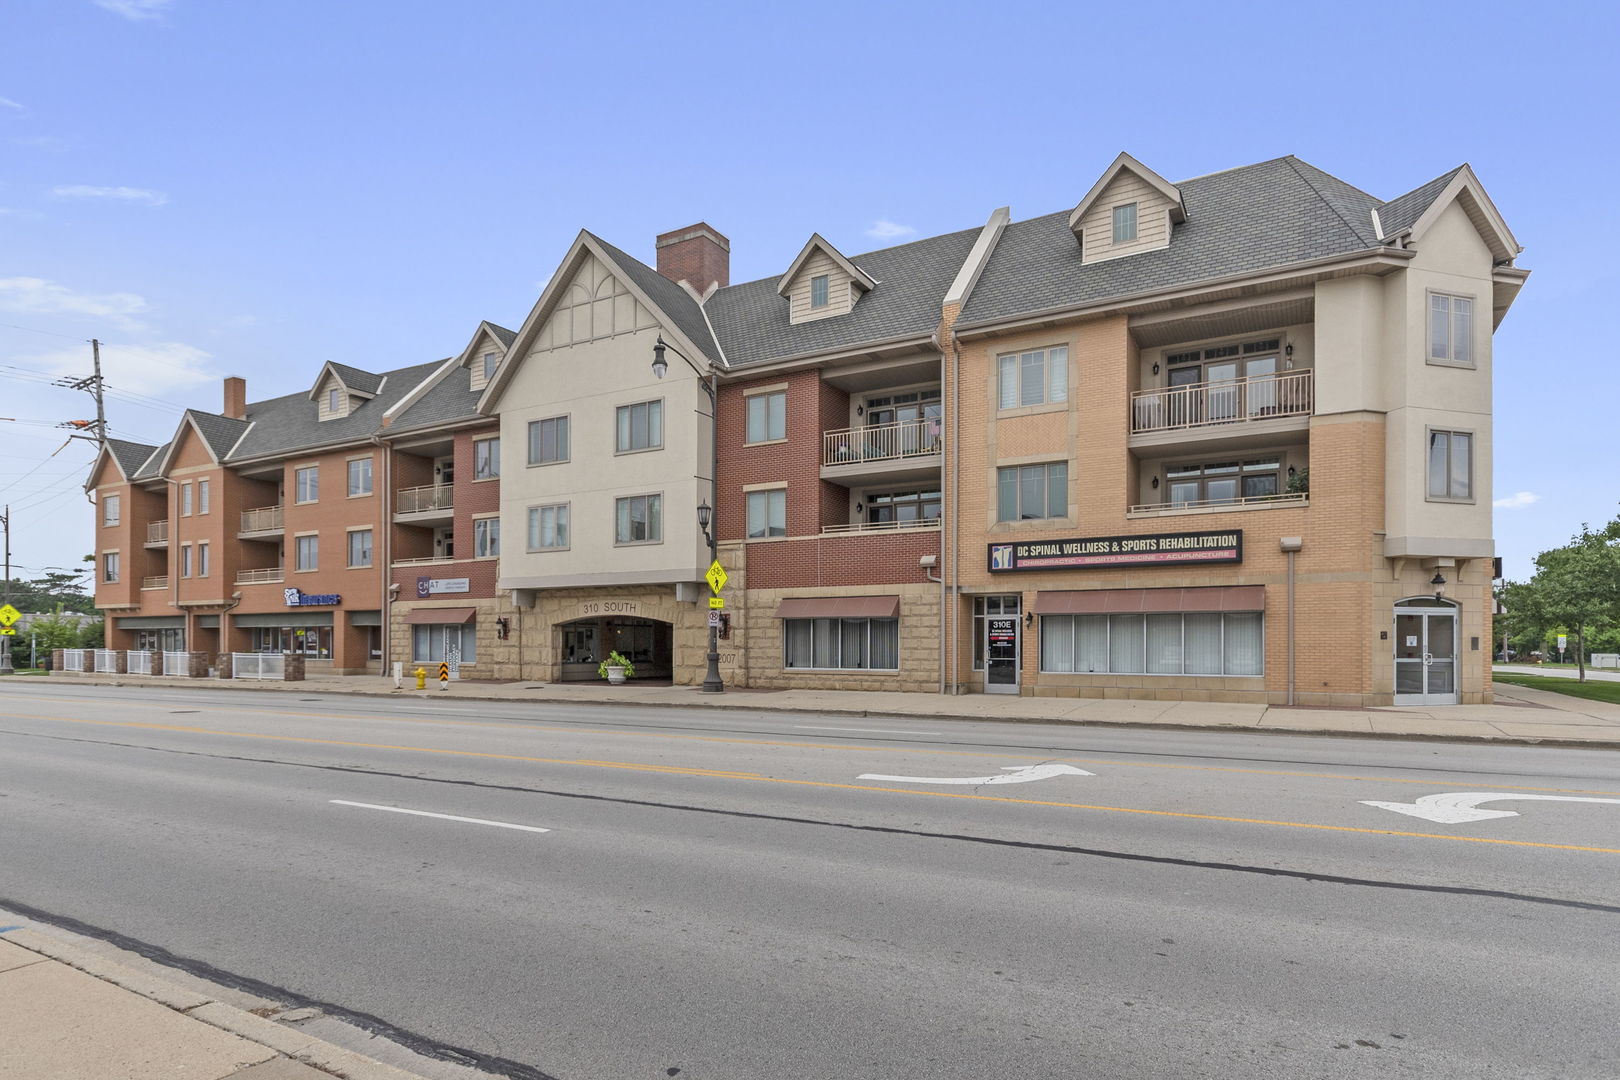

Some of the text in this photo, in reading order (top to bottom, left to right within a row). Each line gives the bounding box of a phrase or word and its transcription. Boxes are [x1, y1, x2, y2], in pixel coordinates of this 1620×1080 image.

[1018, 535, 1236, 556] DC SPINAL WELLNESS & SPORTS REHABILITATION
[1166, 552, 1230, 560] ACUPUNCTURE
[418, 581, 440, 590] CHAT
[583, 602, 637, 614] 310 SOUTH
[718, 653, 736, 664] 2007
